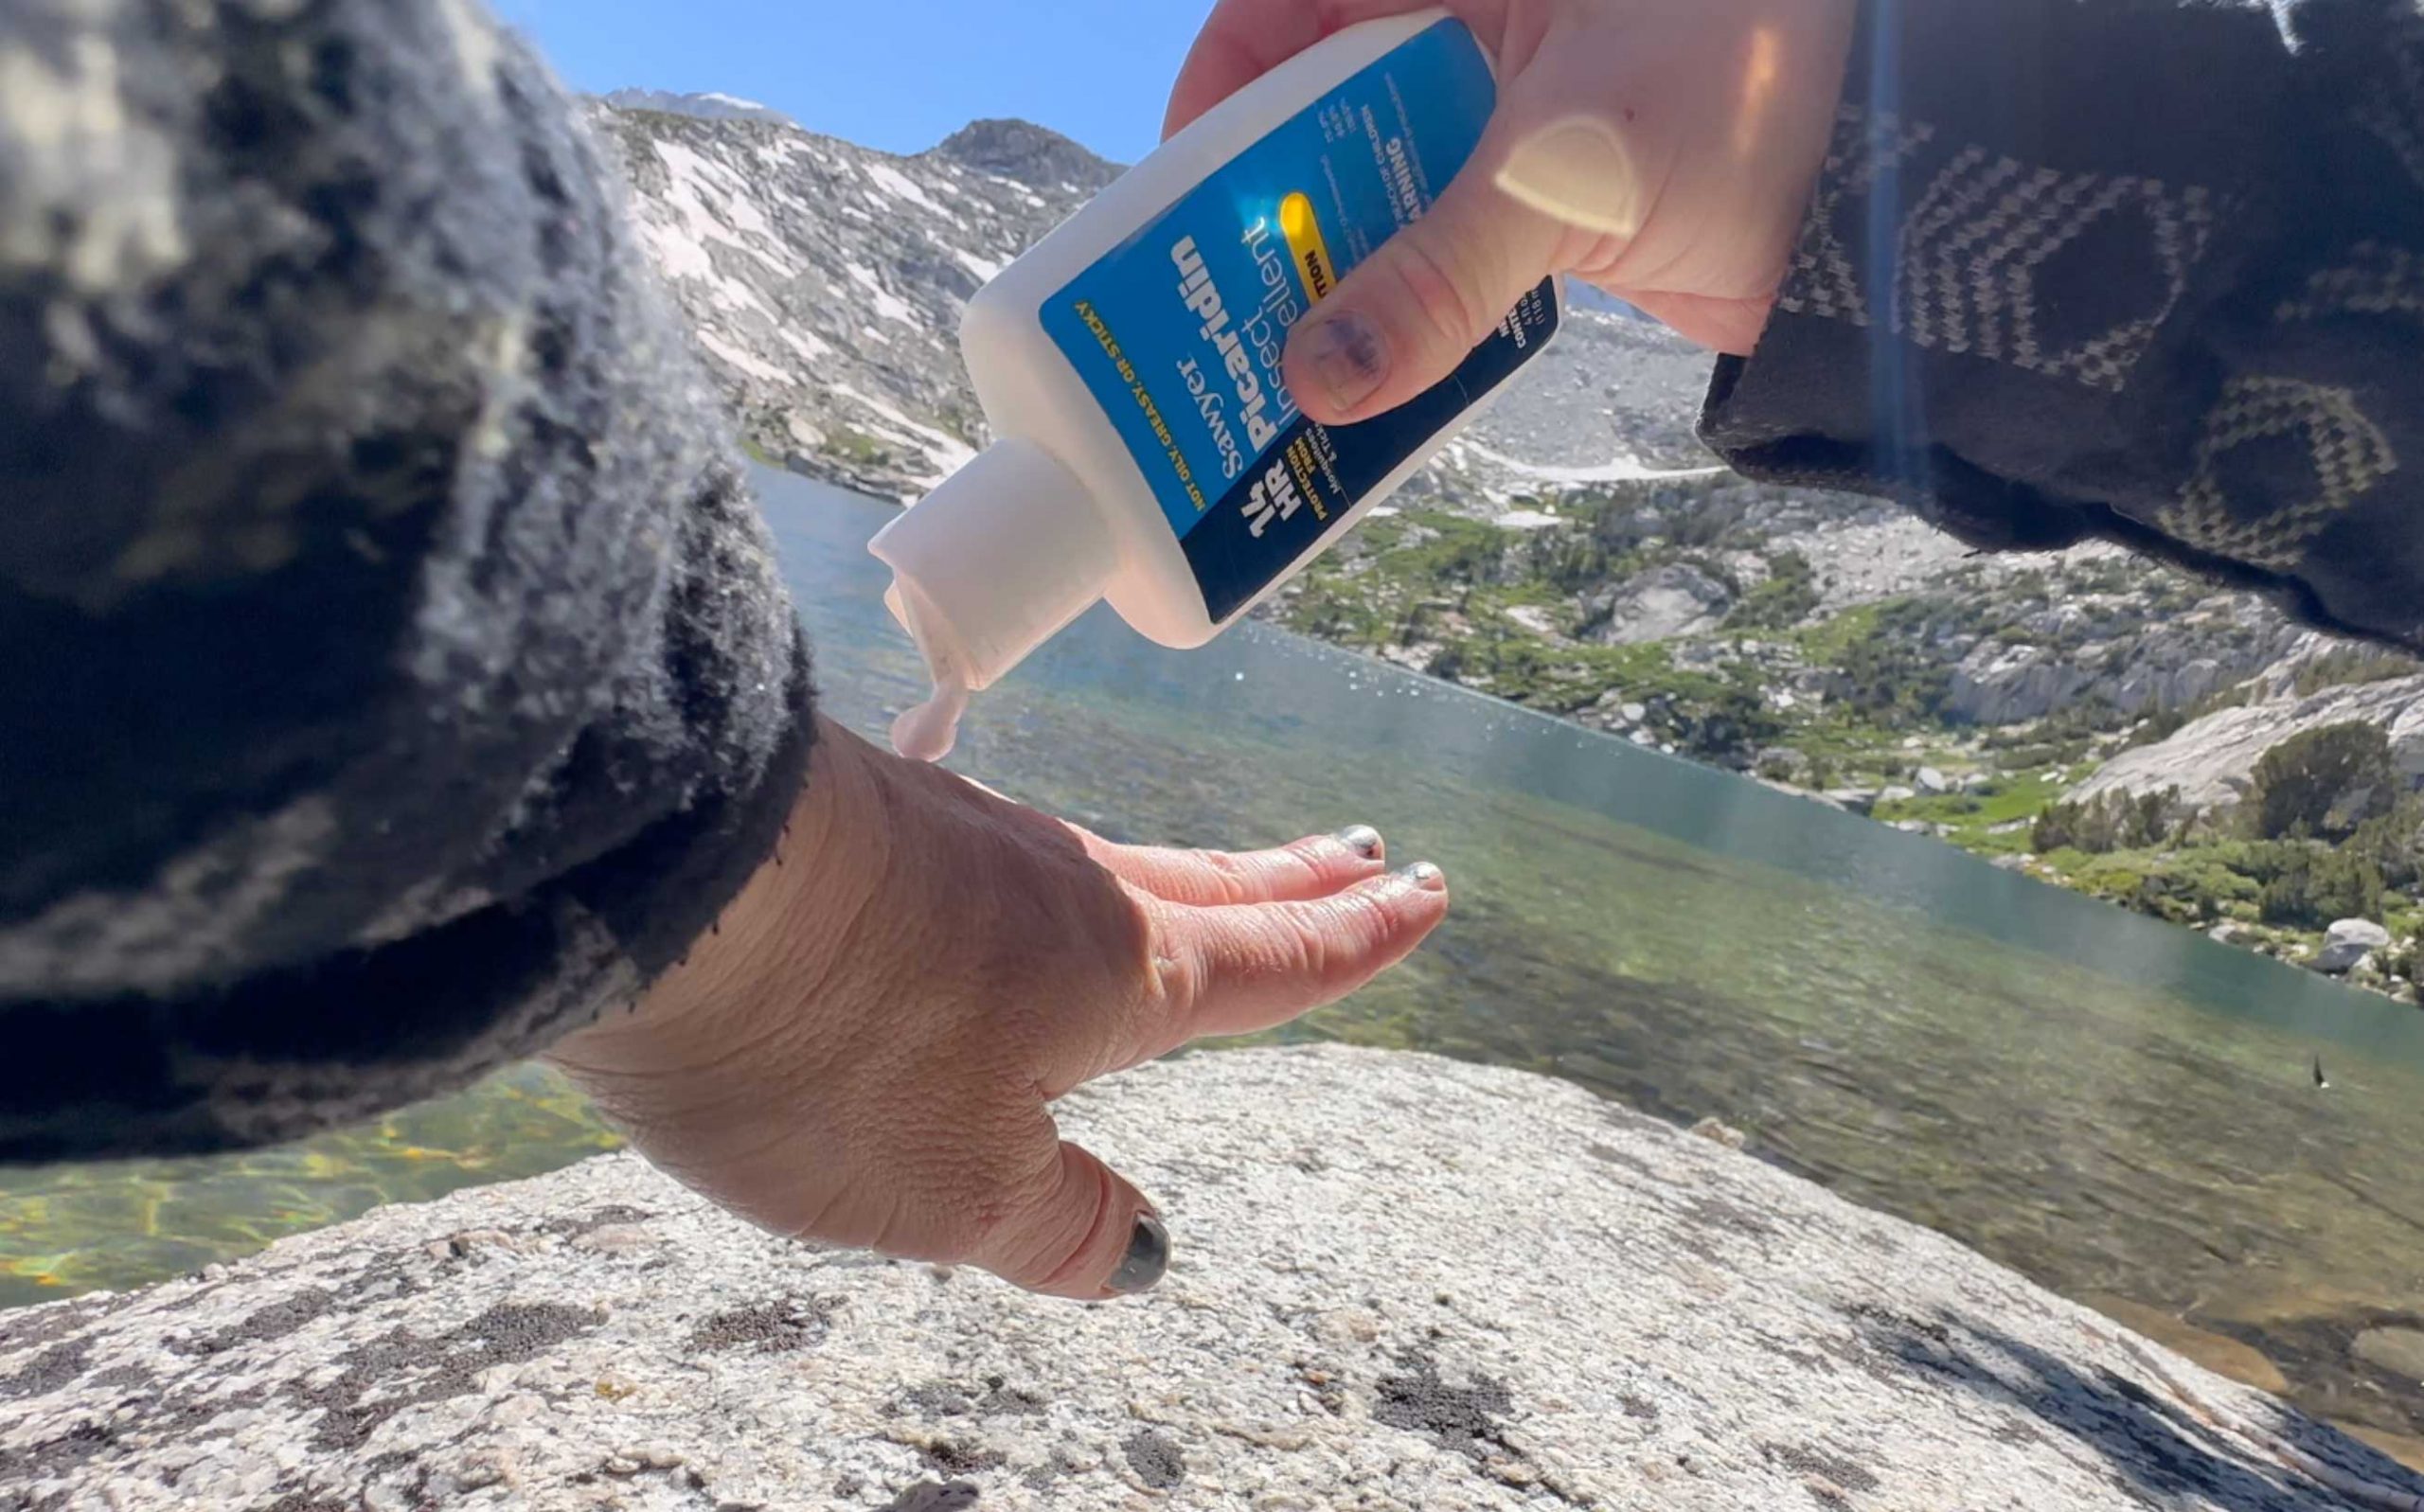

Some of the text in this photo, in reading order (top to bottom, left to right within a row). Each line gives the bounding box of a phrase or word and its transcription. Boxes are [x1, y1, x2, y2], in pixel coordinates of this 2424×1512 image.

[1358, 103, 1385, 166] CHILDREN
[1383, 136, 1421, 221] ARNING
[1240, 215, 1296, 325] ellent
[1304, 248, 1326, 297] TION
[1073, 302, 1120, 359] STICKY
[1168, 234, 1278, 453] Picaridin
[1506, 307, 1526, 348] CONTE
[1115, 356, 1136, 383] OR
[1240, 304, 1298, 426] Insect
[1176, 354, 1246, 480] Sawyer
[1284, 443, 1328, 520] PROTECTION
[1292, 436, 1316, 474] FROM
[1303, 426, 1340, 494] Mosquitoes
[1184, 481, 1206, 511] NOT
[1239, 479, 1275, 538] 14
[1260, 456, 1303, 522] HR
